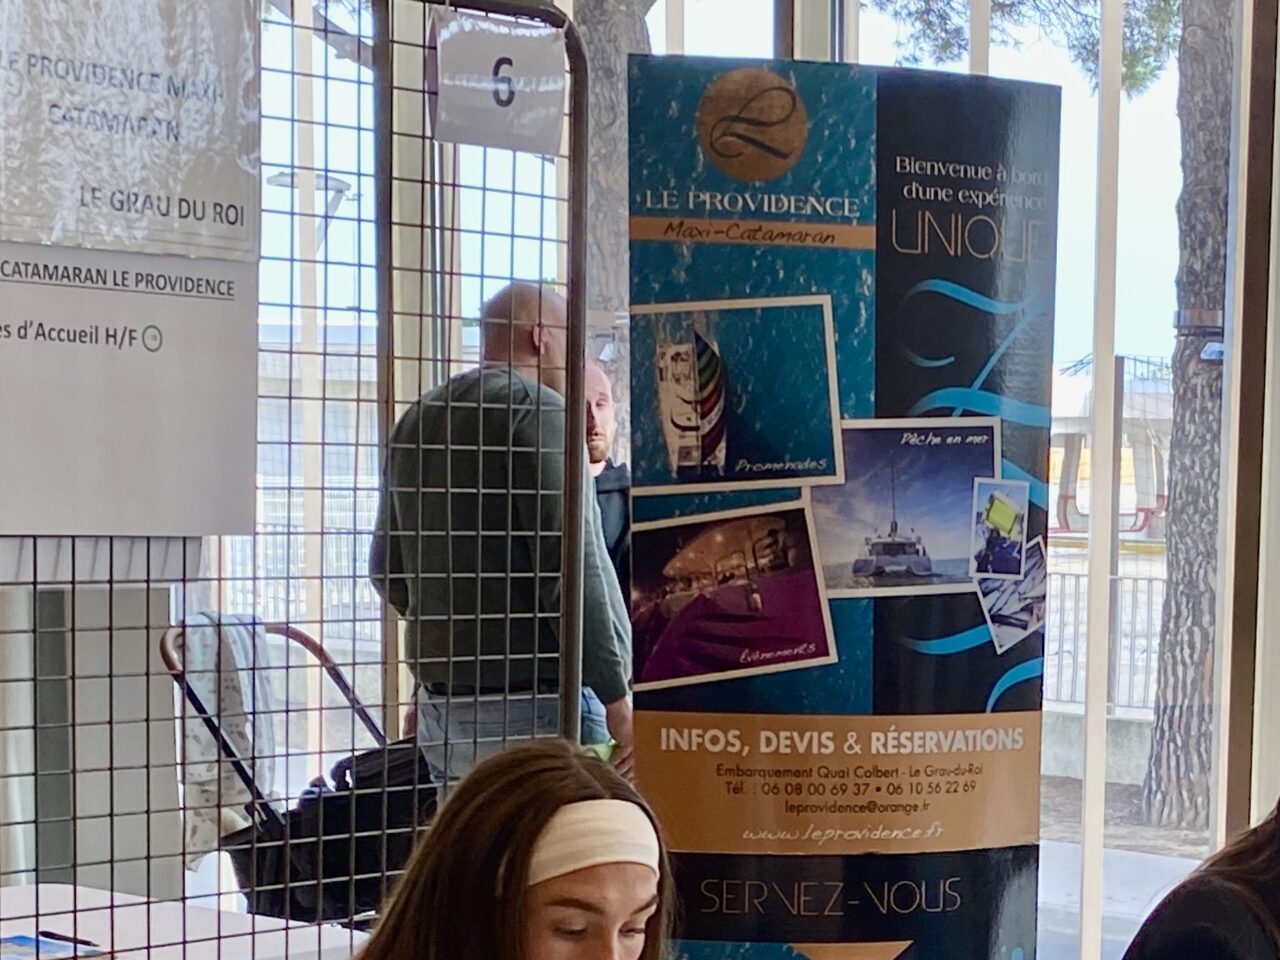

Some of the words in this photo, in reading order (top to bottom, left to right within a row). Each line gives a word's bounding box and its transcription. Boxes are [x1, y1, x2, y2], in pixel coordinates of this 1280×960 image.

[27, 53, 160, 94] PROVIDENCE
[492, 57, 515, 107] 6
[895, 156, 992, 180] Bienvenue
[996, 163, 1006, 182] à
[1011, 166, 1048, 185] bord
[80, 185, 102, 208] LE
[110, 189, 170, 217] GRAU
[178, 197, 205, 222] DU
[213, 202, 244, 227] ROI
[646, 190, 679, 209] LE
[688, 190, 860, 217] PROVIDENCE
[903, 181, 953, 201] d'une
[958, 188, 1046, 210] expérience
[663, 221, 836, 244] Maxi-Catamaran
[892, 208, 1048, 264] UNIQUE
[0, 260, 107, 286] CATAMARAN
[112, 269, 130, 288] LE
[135, 272, 235, 297] PROVIDENCE
[0, 323, 11, 338] s
[105, 326, 138, 350] H/F
[900, 432, 941, 446] Pêche
[946, 435, 961, 445] en
[966, 434, 989, 445] mer
[735, 457, 827, 473] Promenades
[660, 727, 749, 757] INFOS,
[759, 731, 835, 754] DEVIS
[843, 731, 862, 754] &
[871, 724, 1024, 754] RÉSERVATIONS
[716, 762, 813, 780] Embarquement
[817, 765, 849, 779] Quai
[854, 765, 899, 779] Colbert
[909, 765, 921, 778] Le
[924, 763, 984, 777] Grau-du-Roi
[761, 782, 780, 796] 06
[785, 782, 803, 796] 08
[808, 782, 826, 796] 00
[830, 783, 848, 796] 69
[853, 783, 870, 796] 37
[887, 782, 903, 796] 06
[909, 782, 923, 795] 10
[928, 781, 942, 794] 56
[945, 781, 959, 794] 22
[963, 780, 977, 793] 69
[785, 799, 930, 816] leprovidence@orange.fr
[743, 820, 944, 846] www.leprovidence.fr
[700, 877, 961, 916] SERVEZ-VOUS
